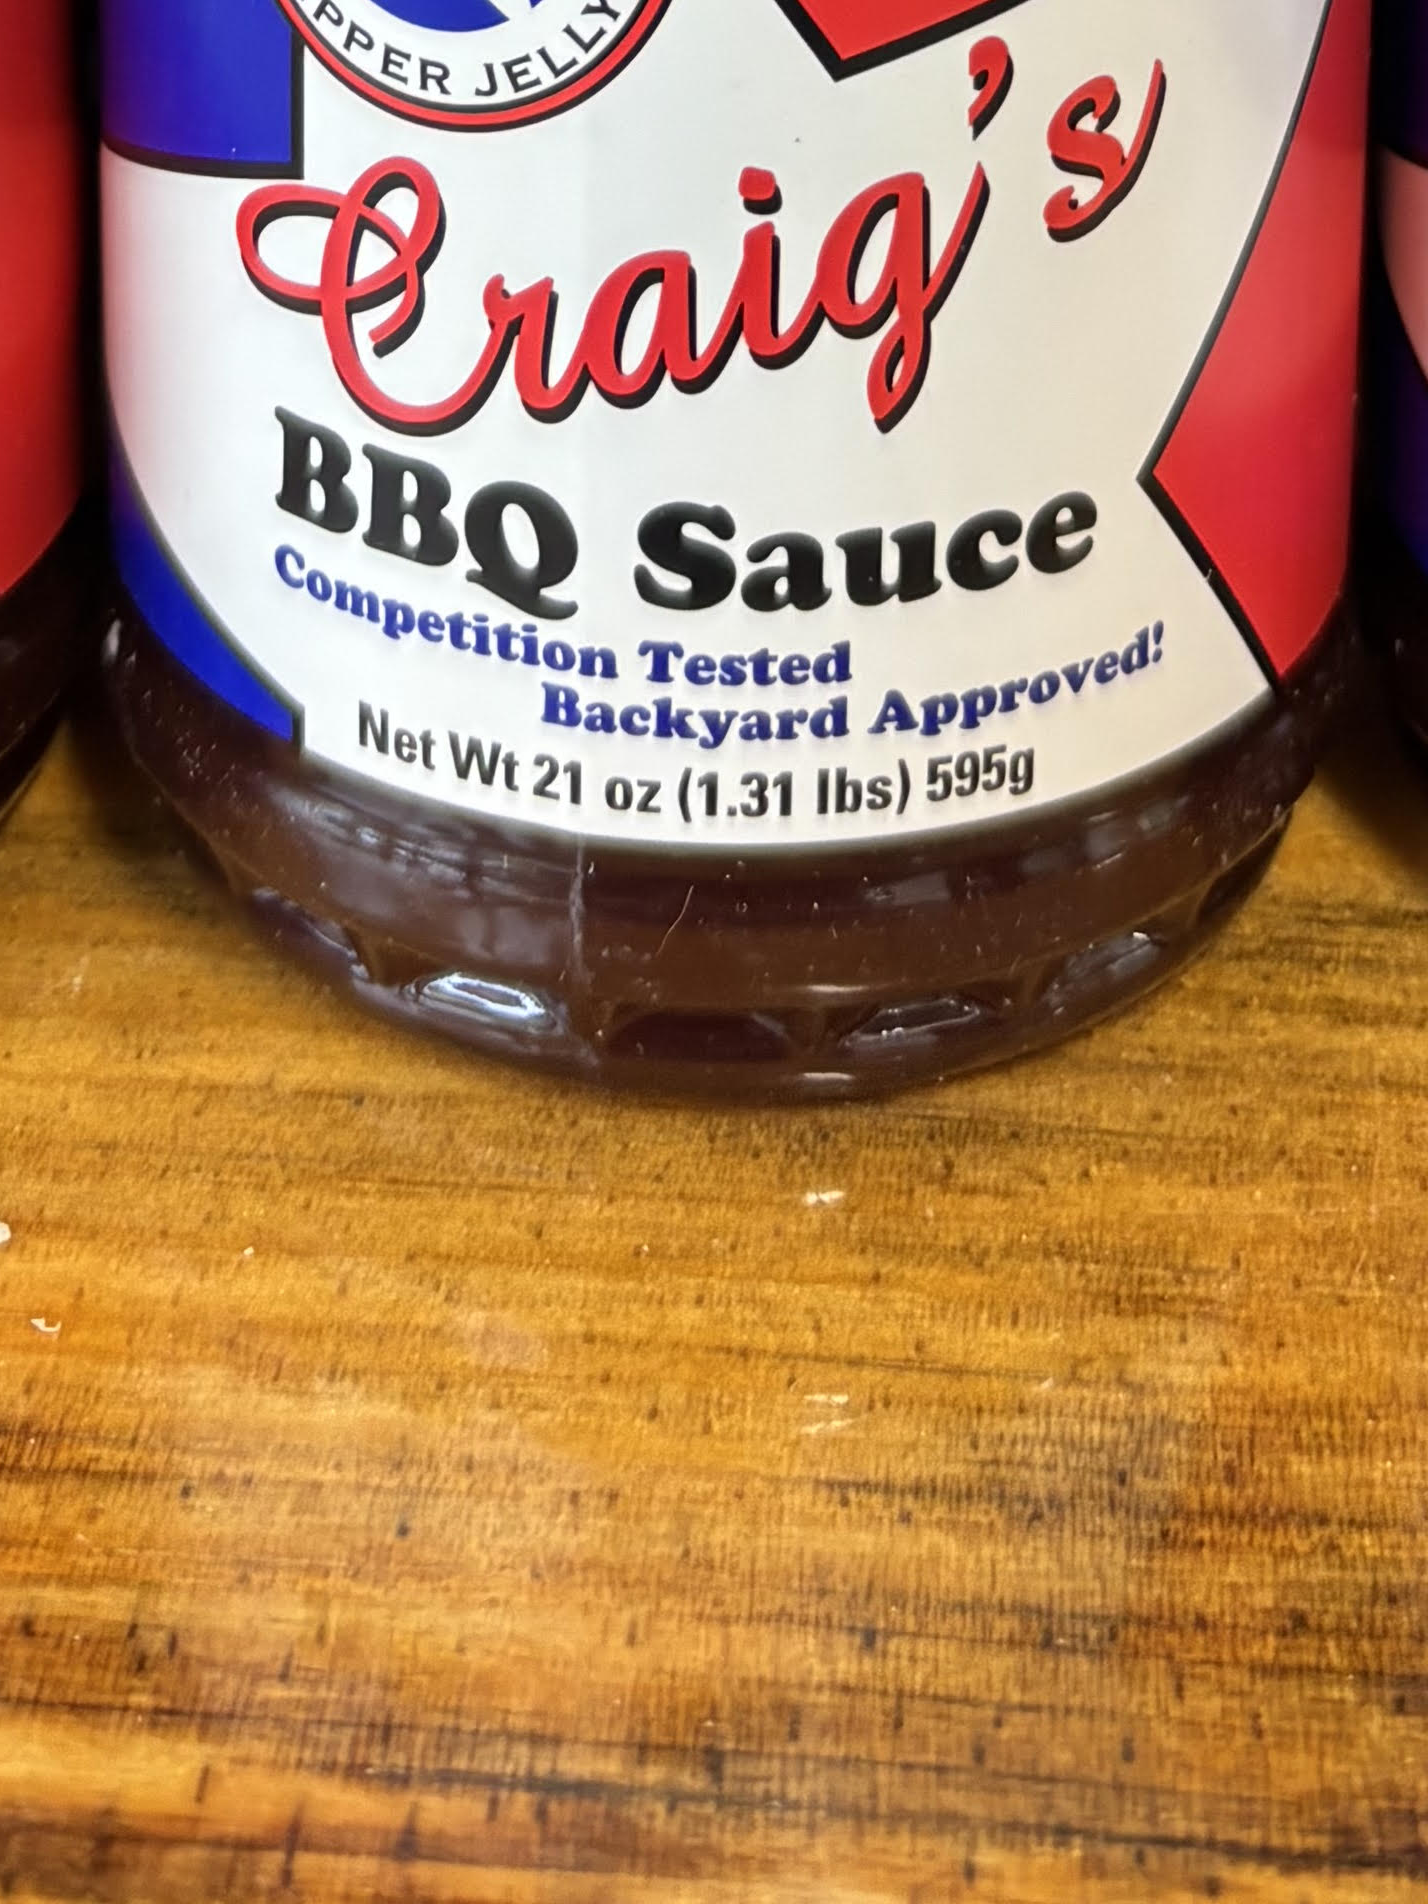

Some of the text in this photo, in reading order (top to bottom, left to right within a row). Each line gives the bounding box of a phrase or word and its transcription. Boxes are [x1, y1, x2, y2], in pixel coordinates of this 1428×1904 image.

[235, 36, 1166, 437] Craig's
[273, 405, 1099, 620] BBQ Sauce
[274, 544, 852, 688] Competition Tested
[541, 620, 1166, 750] Backyard Approved!
[357, 700, 1037, 822] Net Wt 21 oz (1.31 lbs) 595g
